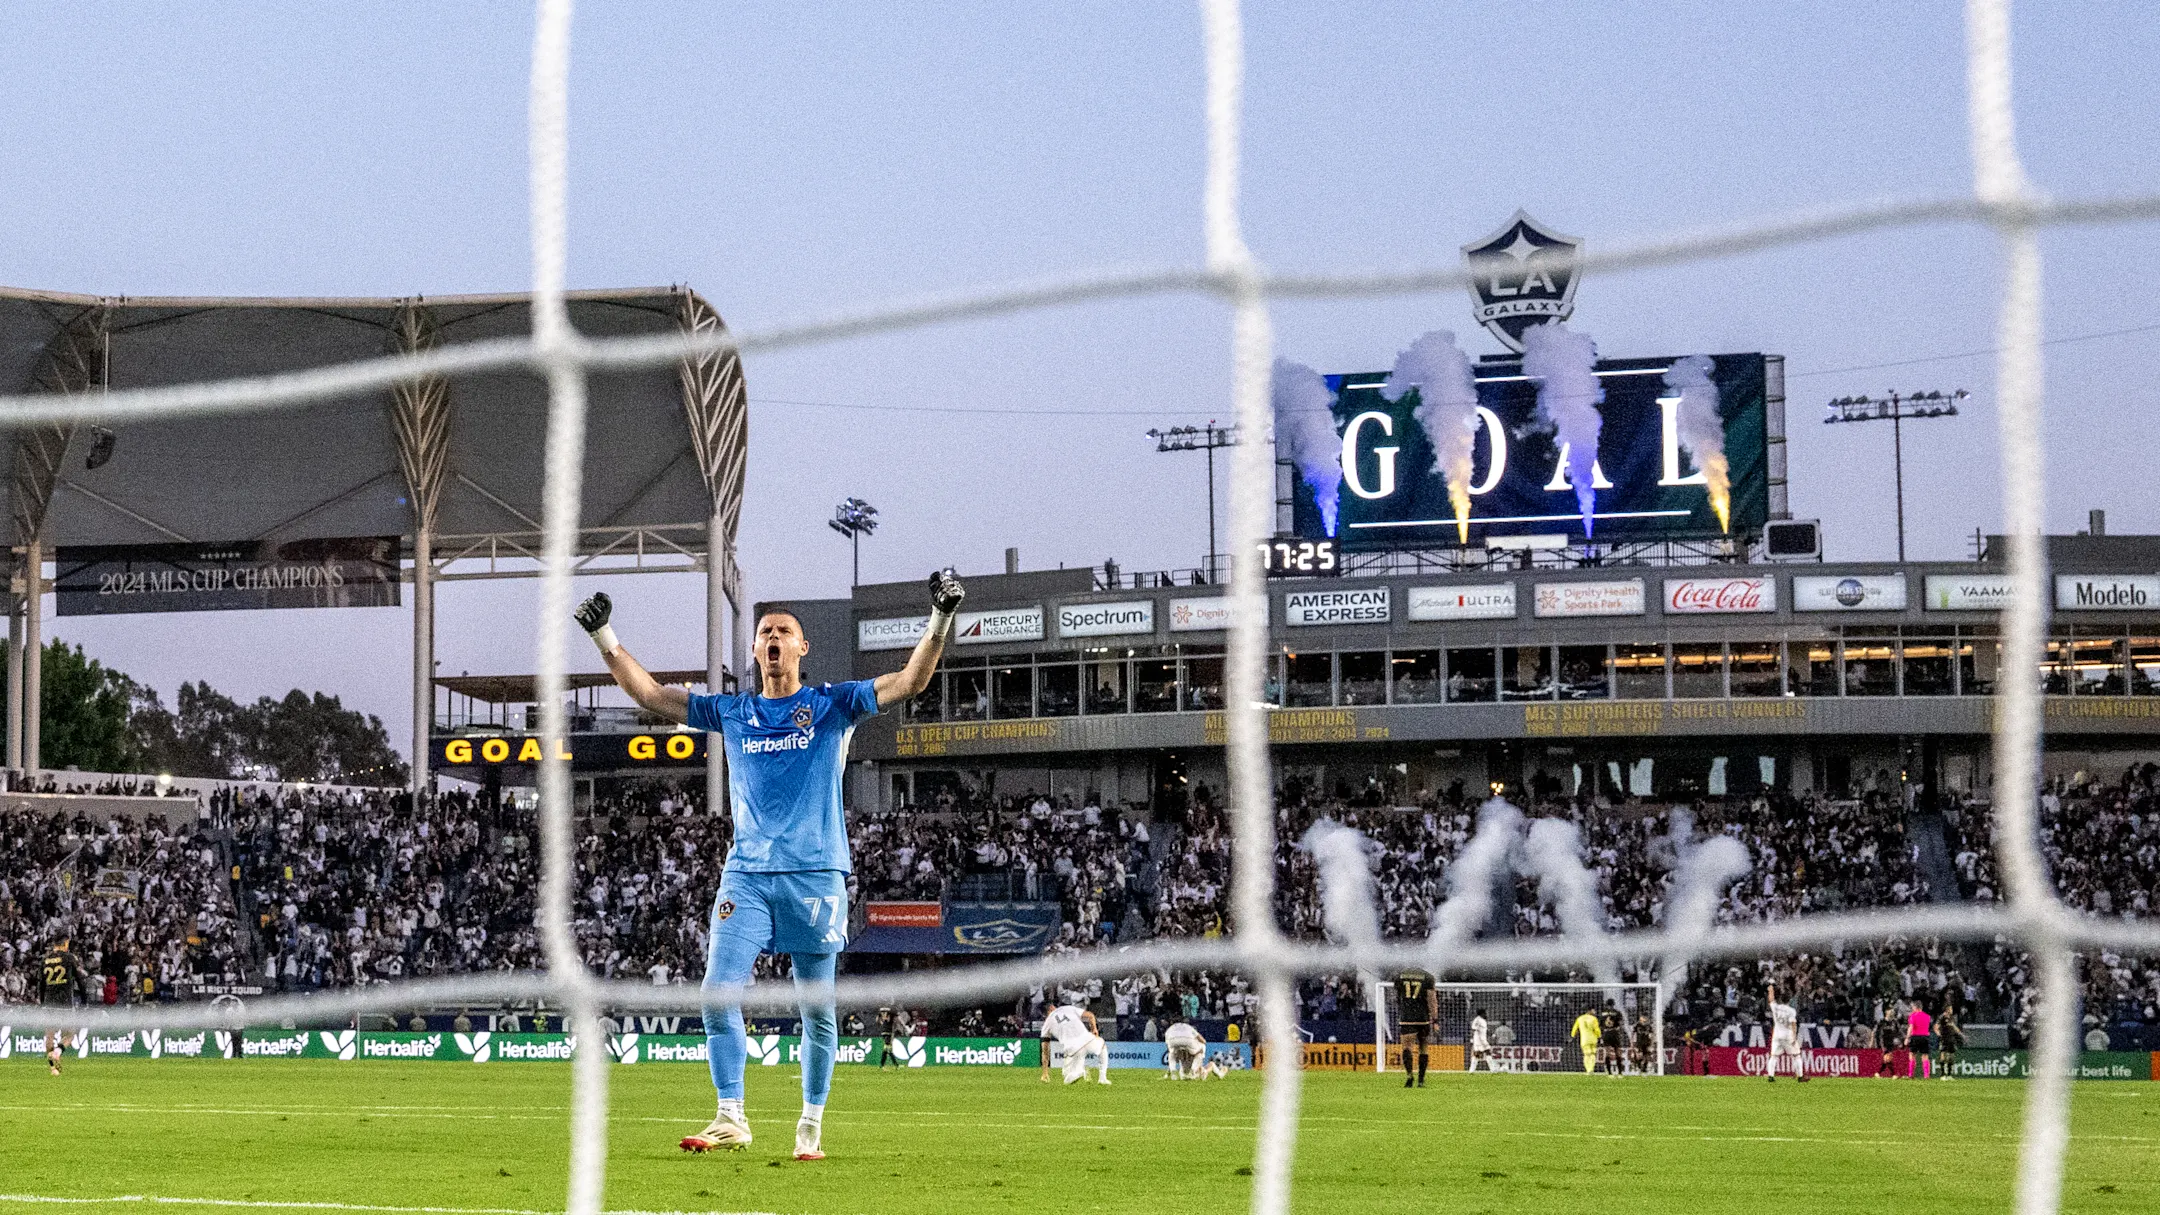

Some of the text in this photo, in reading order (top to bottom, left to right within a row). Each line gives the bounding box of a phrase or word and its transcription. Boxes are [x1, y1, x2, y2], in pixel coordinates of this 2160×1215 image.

[1484, 302, 1564, 316] GALAXY
[1257, 542, 1335, 570] 77:25
[100, 565, 345, 595] 2024 MLS CUP CHAMPIONS
[1288, 592, 1386, 609] AMERICAN
[1467, 595, 1512, 606] ULTRA
[1564, 586, 1640, 599] Dignity Health
[1960, 587, 2018, 596] YAAMA
[2076, 582, 2147, 605] Modelo
[1303, 607, 1388, 622] EXPRESS
[1564, 600, 1622, 611] Sports Park
[864, 622, 911, 636] kinecta
[983, 614, 1040, 627] MERCURY
[1061, 610, 1144, 630] Spectrum
[983, 624, 1042, 636] INSURANCE
[1271, 710, 1356, 728] CHAMPIONS
[1525, 704, 1557, 720] MLS
[920, 727, 951, 741] OPEN
[954, 725, 979, 740] CUP
[982, 722, 1057, 738] CHAMPIONS
[445, 734, 706, 762] GOAL GO
[741, 733, 809, 754] Herbalife
[803, 895, 840, 927] 77
[43, 965, 68, 985] 22
[1403, 980, 1422, 999] 17
[1055, 1014, 1071, 1024] 4
[15, 1035, 52, 1053] Herbal
[92, 1036, 132, 1053] Herbalife
[164, 1036, 202, 1053] Herbalife
[363, 1039, 434, 1057] Herbalife
[499, 1041, 571, 1059] Herbalife
[647, 1043, 709, 1061] Herbali
[789, 1045, 865, 1063] Halife
[935, 1046, 1014, 1065] Herbalife
[1737, 1049, 1859, 1076] Capain Morgan
[2081, 1065, 2109, 1077] best
[2111, 1065, 2132, 1077] life
